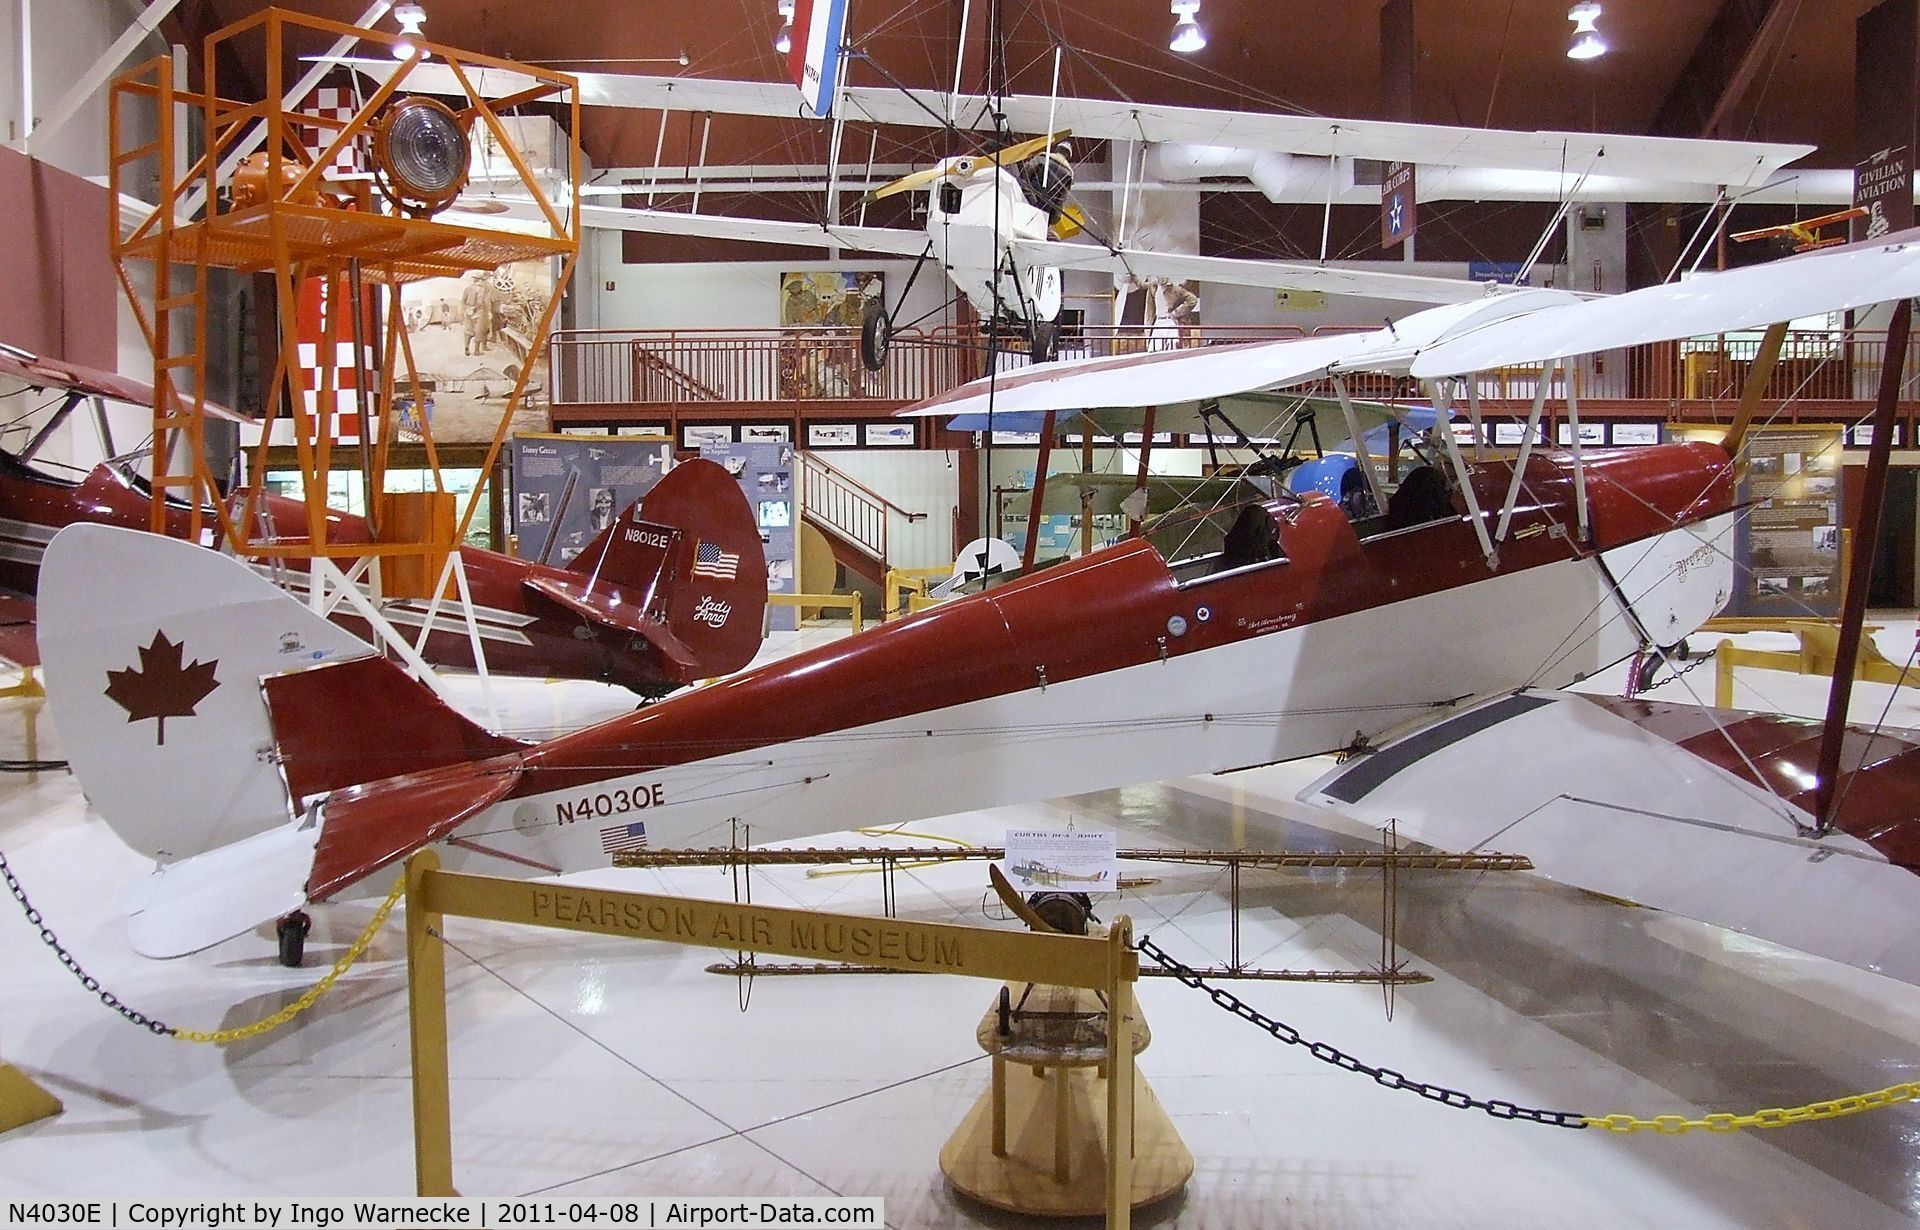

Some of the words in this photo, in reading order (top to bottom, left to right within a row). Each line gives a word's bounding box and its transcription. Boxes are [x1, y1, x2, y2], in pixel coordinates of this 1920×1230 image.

[1382, 180, 1393, 196] AIR
[1392, 167, 1410, 190] CORPS
[1859, 160, 1904, 187] CIVILIAN
[1856, 174, 1906, 202] AVIATION
[624, 528, 668, 549] N8012E
[693, 608, 724, 625] Anna
[695, 595, 731, 624] Lady
[556, 783, 665, 825] N4030E
[531, 890, 696, 937] PEARSON
[712, 911, 773, 946] AIR
[789, 919, 964, 967] MUSEUM
